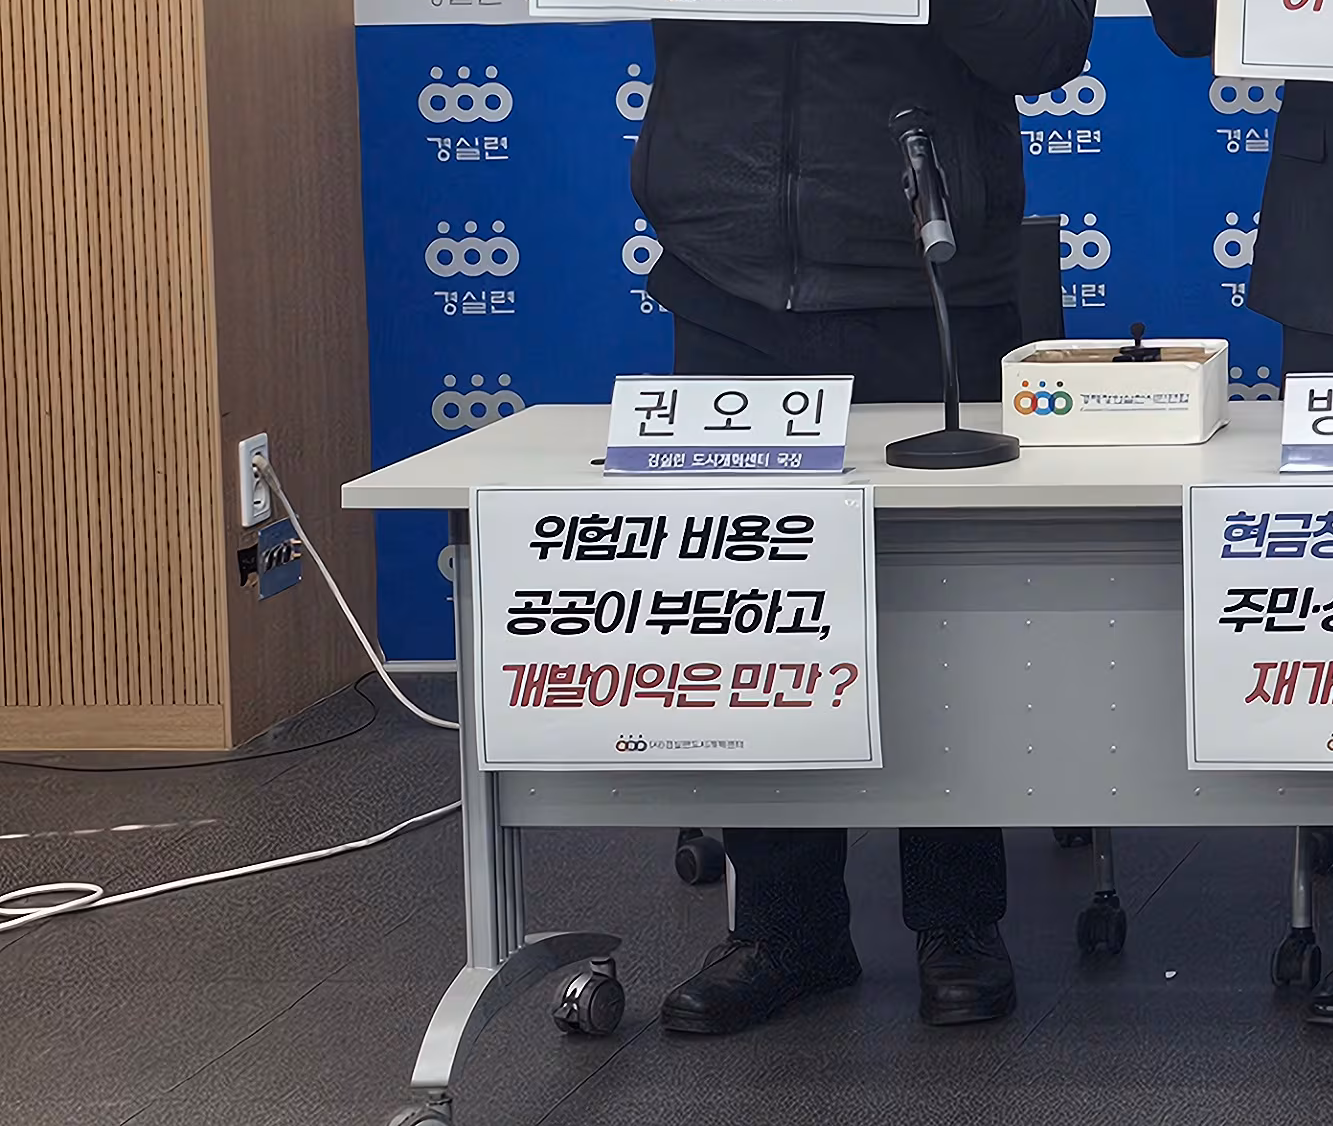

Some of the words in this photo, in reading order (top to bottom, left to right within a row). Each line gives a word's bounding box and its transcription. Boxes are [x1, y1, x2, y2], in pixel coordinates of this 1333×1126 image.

[427, 135, 509, 162] 경실련
[1019, 129, 1102, 156] 경실련
[1216, 128, 1270, 154] 경실
[434, 290, 516, 317] 경실련
[529, 513, 669, 561] 위험과
[678, 514, 815, 562] 비용은
[506, 589, 643, 636] 공공이
[644, 588, 831, 641] 부담하고,
[502, 662, 722, 708] 개발이익은
